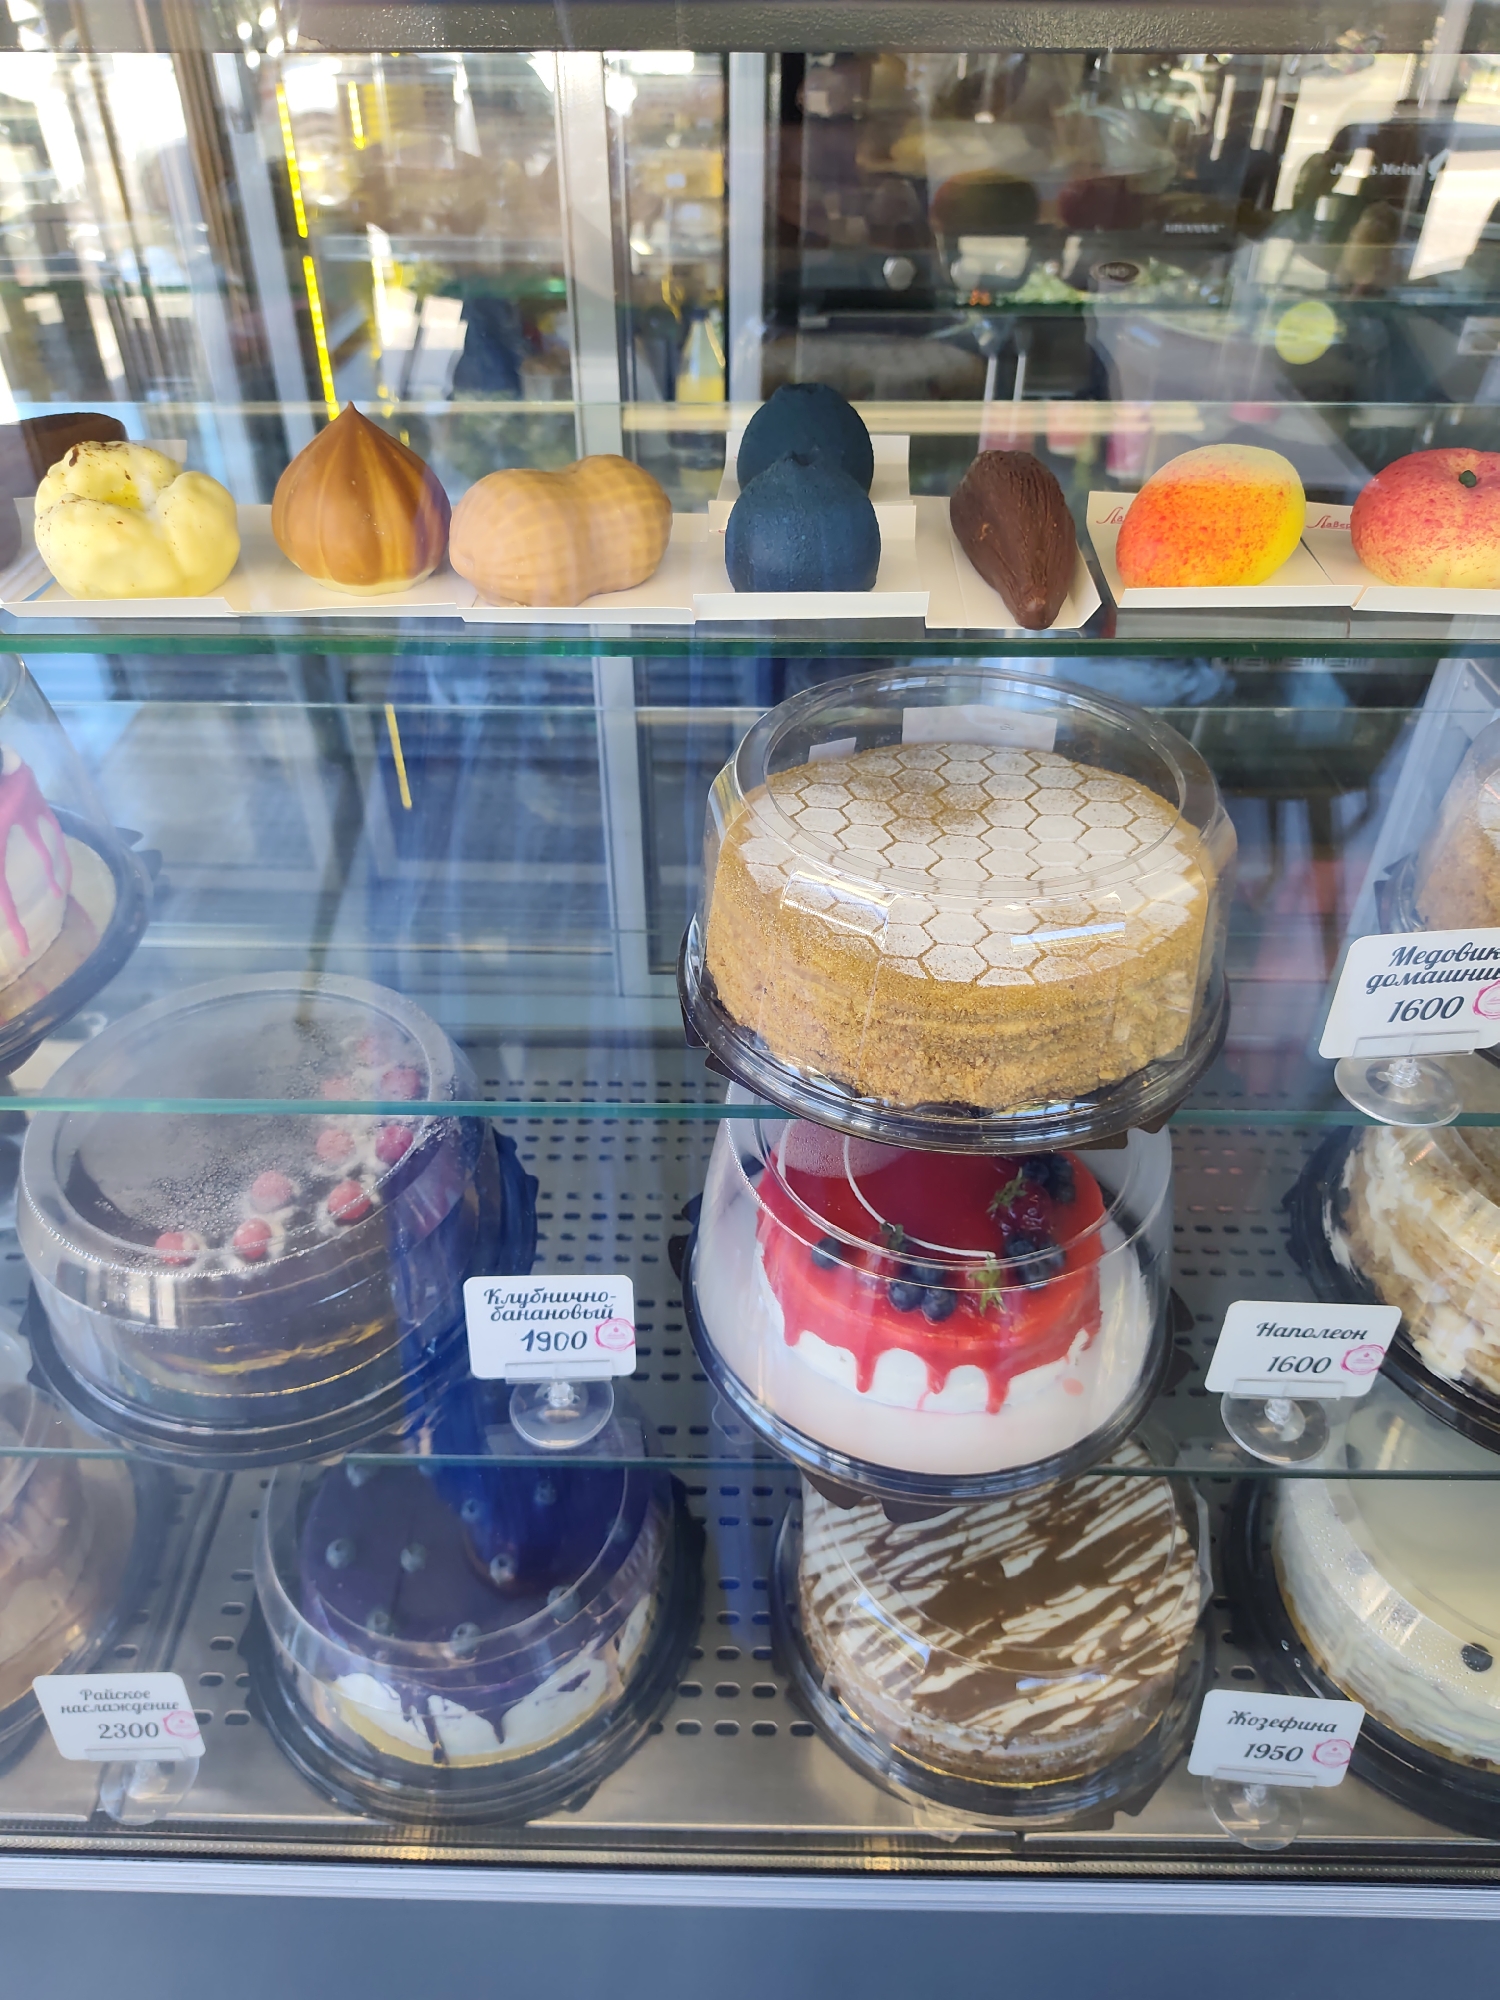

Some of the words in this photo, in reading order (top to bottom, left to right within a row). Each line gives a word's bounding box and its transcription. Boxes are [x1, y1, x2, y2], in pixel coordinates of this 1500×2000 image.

[1387, 996, 1465, 1023] 1600
[483, 1287, 617, 1308] Клубнично-
[490, 1303, 614, 1321] банановый
[1256, 1321, 1369, 1340] Наполеон
[520, 1329, 587, 1352] 1900
[1266, 1355, 1332, 1374] 1600
[79, 1688, 151, 1701] Райское
[60, 1701, 179, 1714] наслаждение
[98, 1722, 160, 1739] 2300
[1227, 1710, 1338, 1733] Жозефина
[1243, 1743, 1304, 1762] 1950
